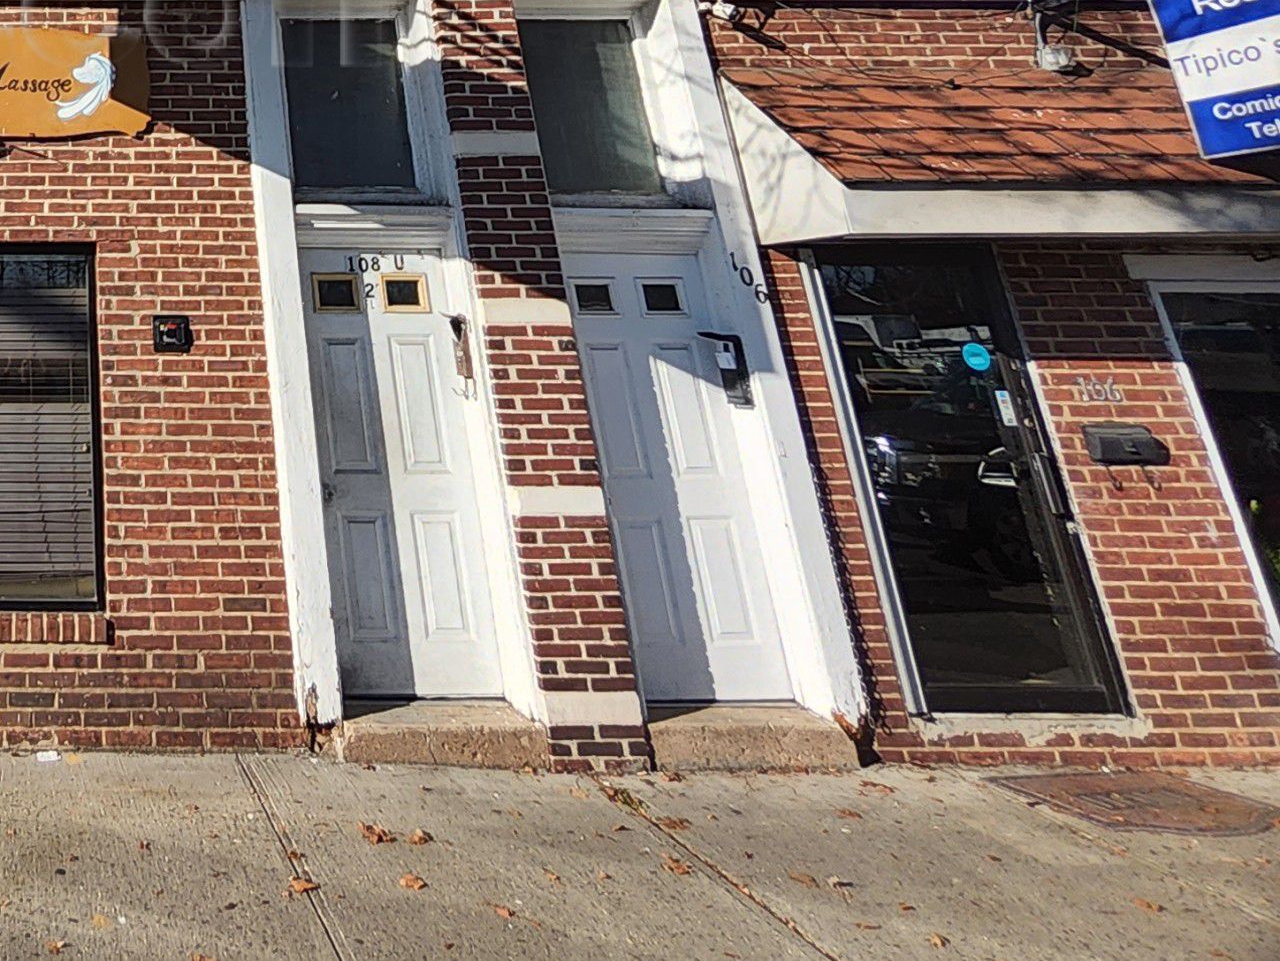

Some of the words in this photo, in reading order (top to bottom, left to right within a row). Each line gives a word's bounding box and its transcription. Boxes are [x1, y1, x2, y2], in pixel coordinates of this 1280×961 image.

[348, 256, 381, 273] 108
[729, 251, 769, 304] 106
[364, 283, 375, 298] 2
[1077, 376, 1122, 401] 106
